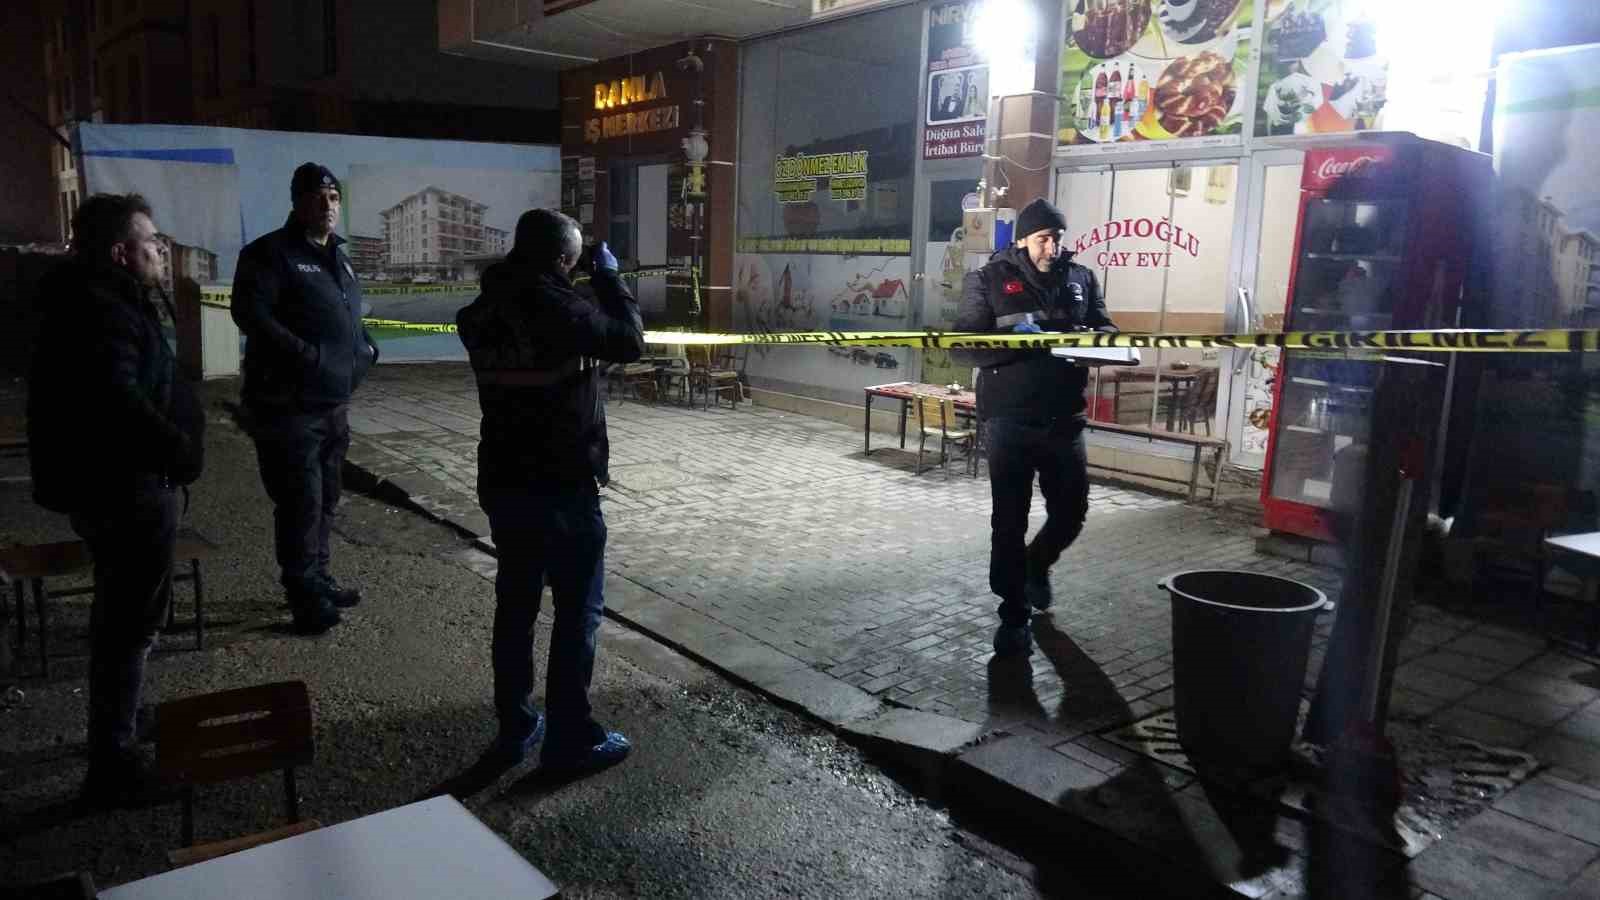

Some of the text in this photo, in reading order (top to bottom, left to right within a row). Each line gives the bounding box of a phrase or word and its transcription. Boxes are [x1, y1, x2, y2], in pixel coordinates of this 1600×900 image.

[594, 71, 667, 109] DAMLA
[926, 127, 961, 142] Düğün
[926, 143, 958, 157] İrtibat
[1074, 216, 1200, 257] KADIOĞLU
[1097, 251, 1131, 270] ÇAY
